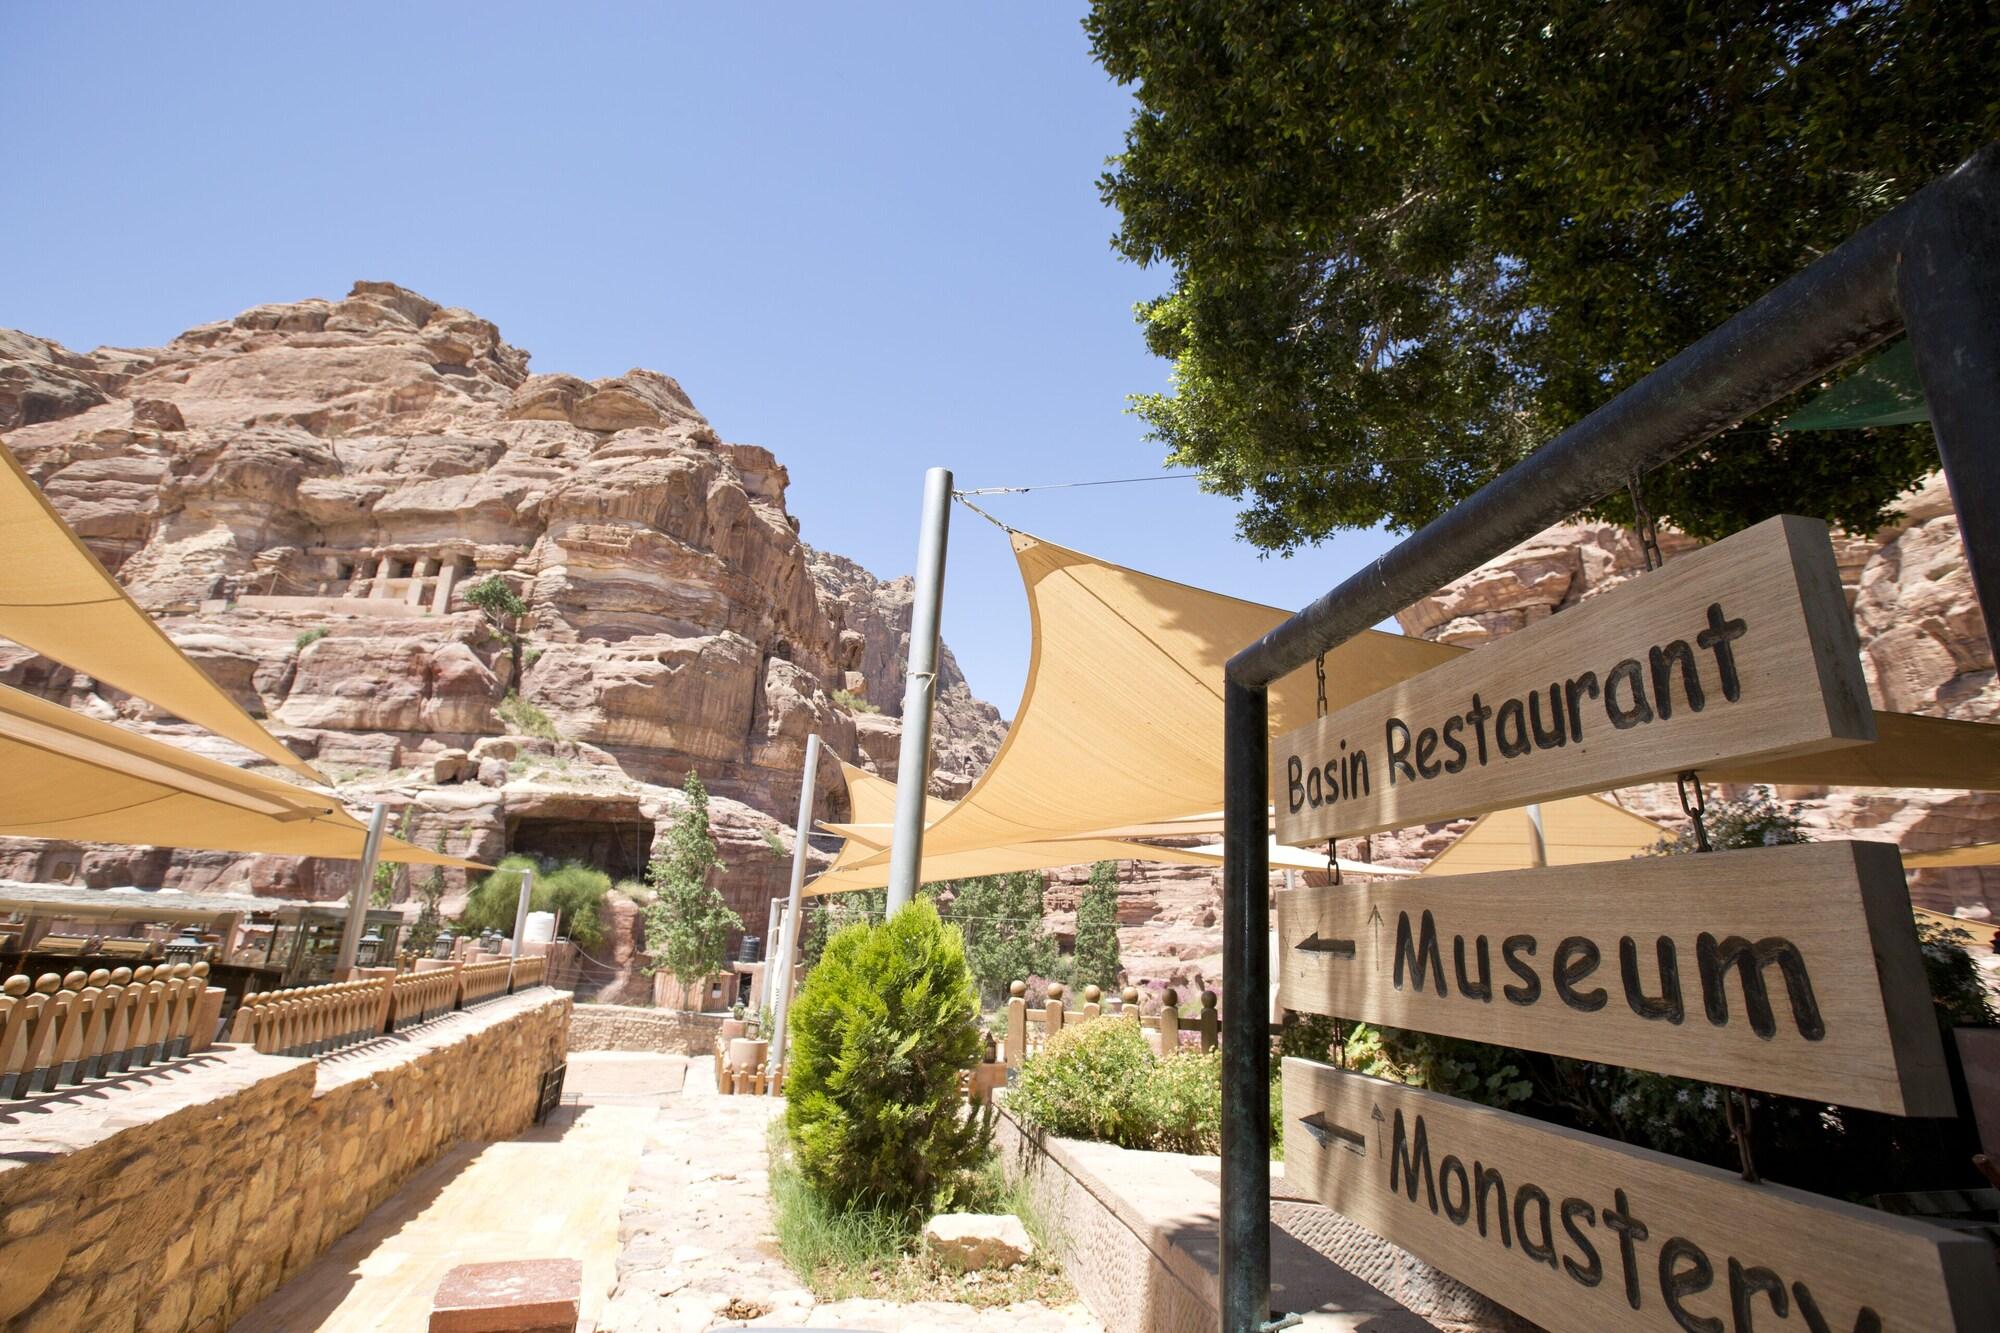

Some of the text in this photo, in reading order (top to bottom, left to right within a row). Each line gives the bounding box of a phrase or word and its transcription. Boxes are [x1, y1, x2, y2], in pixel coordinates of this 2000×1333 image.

[1288, 602, 1748, 814] Basin Restaurant
[1394, 909, 1826, 1042] Museum
